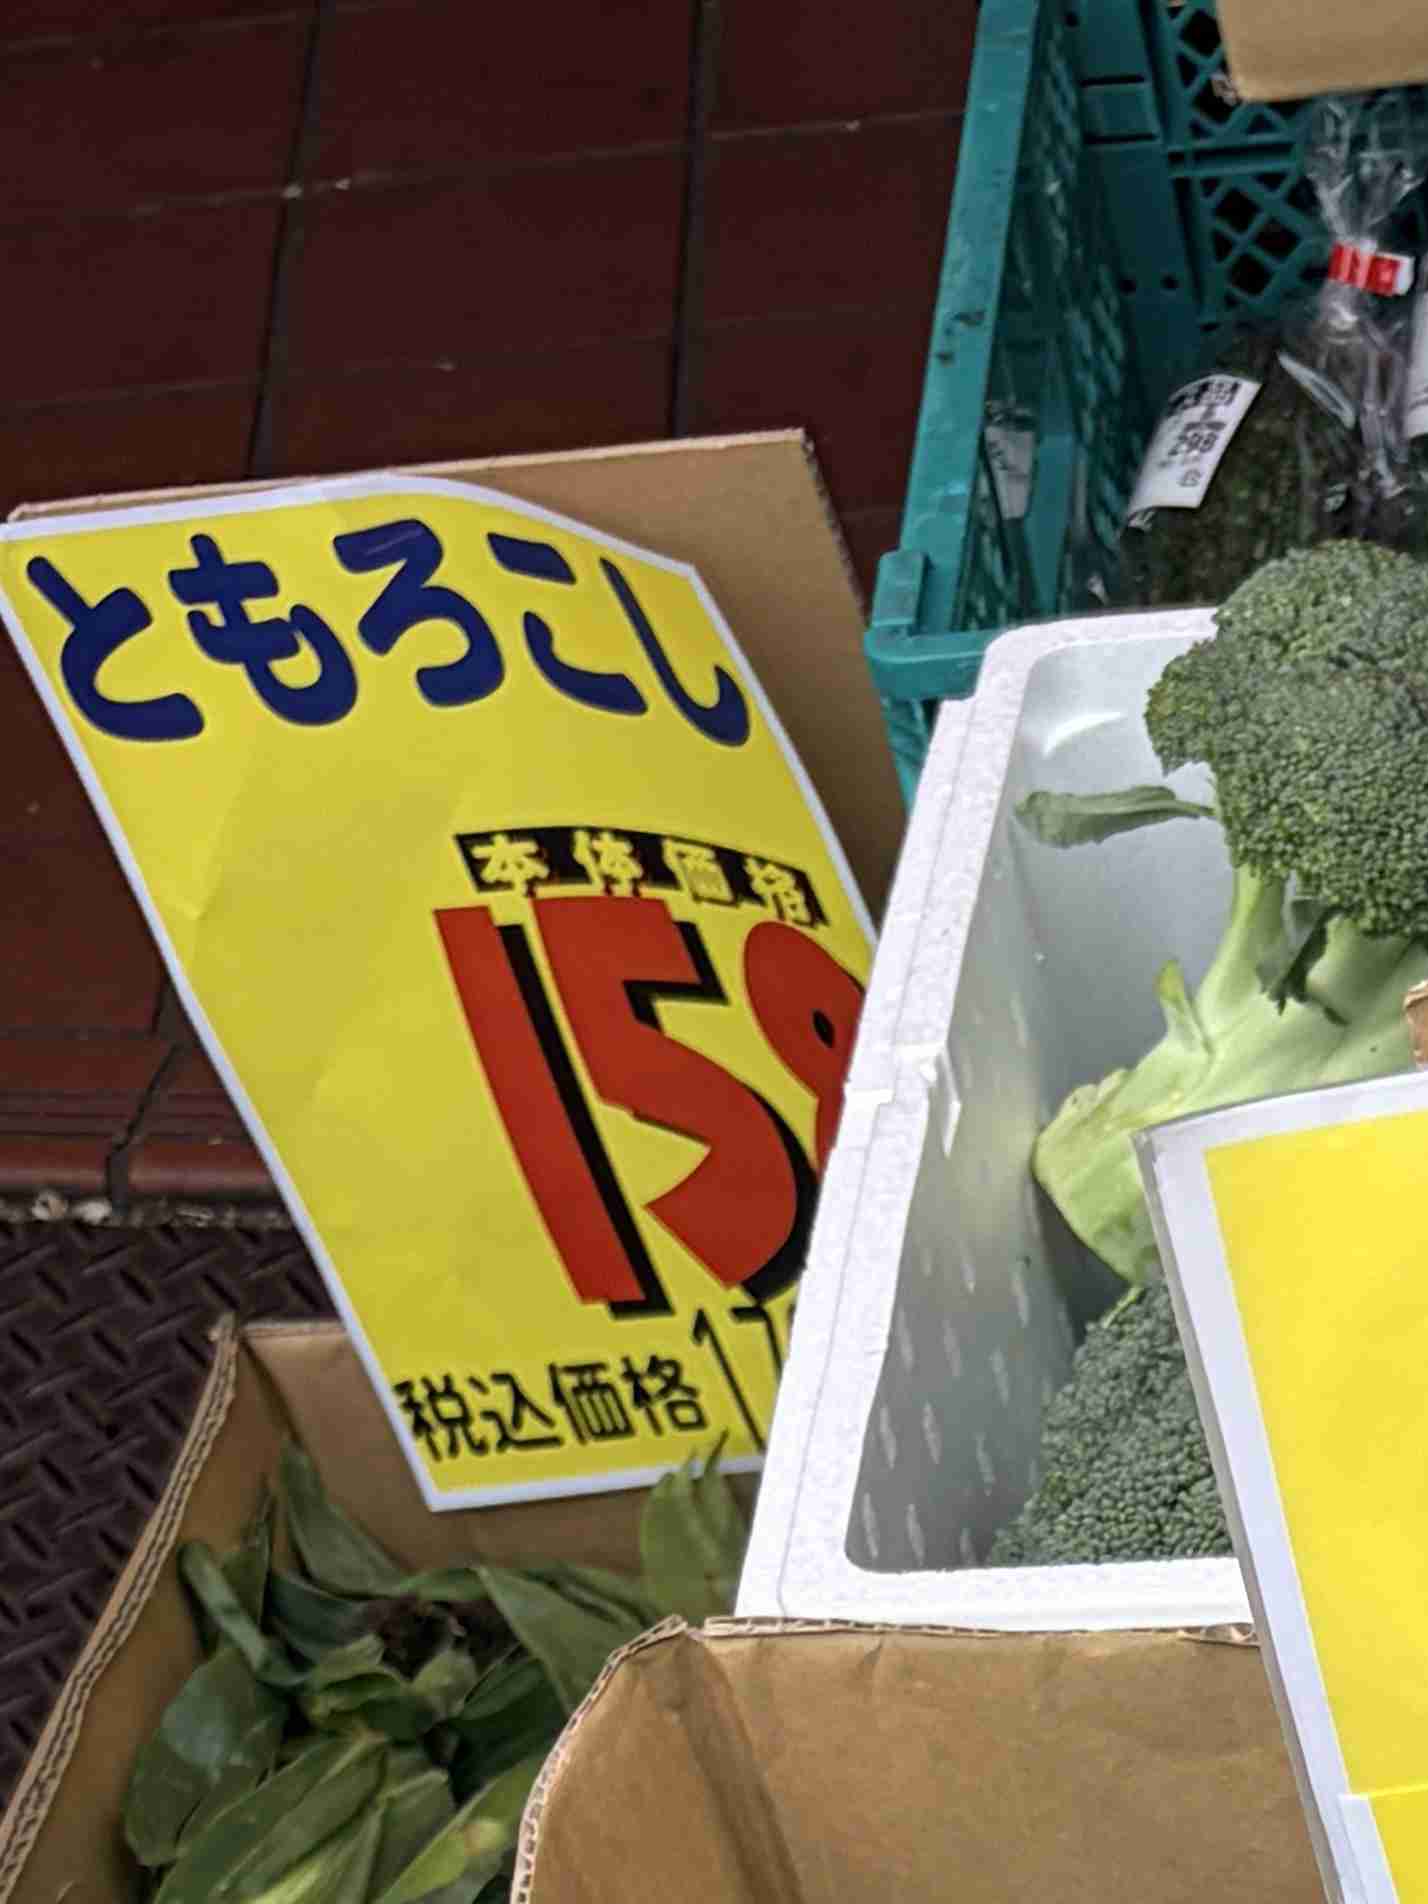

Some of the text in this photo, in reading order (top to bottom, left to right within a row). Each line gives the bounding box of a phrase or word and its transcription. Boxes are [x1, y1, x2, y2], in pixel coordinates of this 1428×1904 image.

[26, 516, 752, 748] ともろこし
[473, 832, 820, 928] 本体価格
[394, 1302, 795, 1460] 税込価格 17
